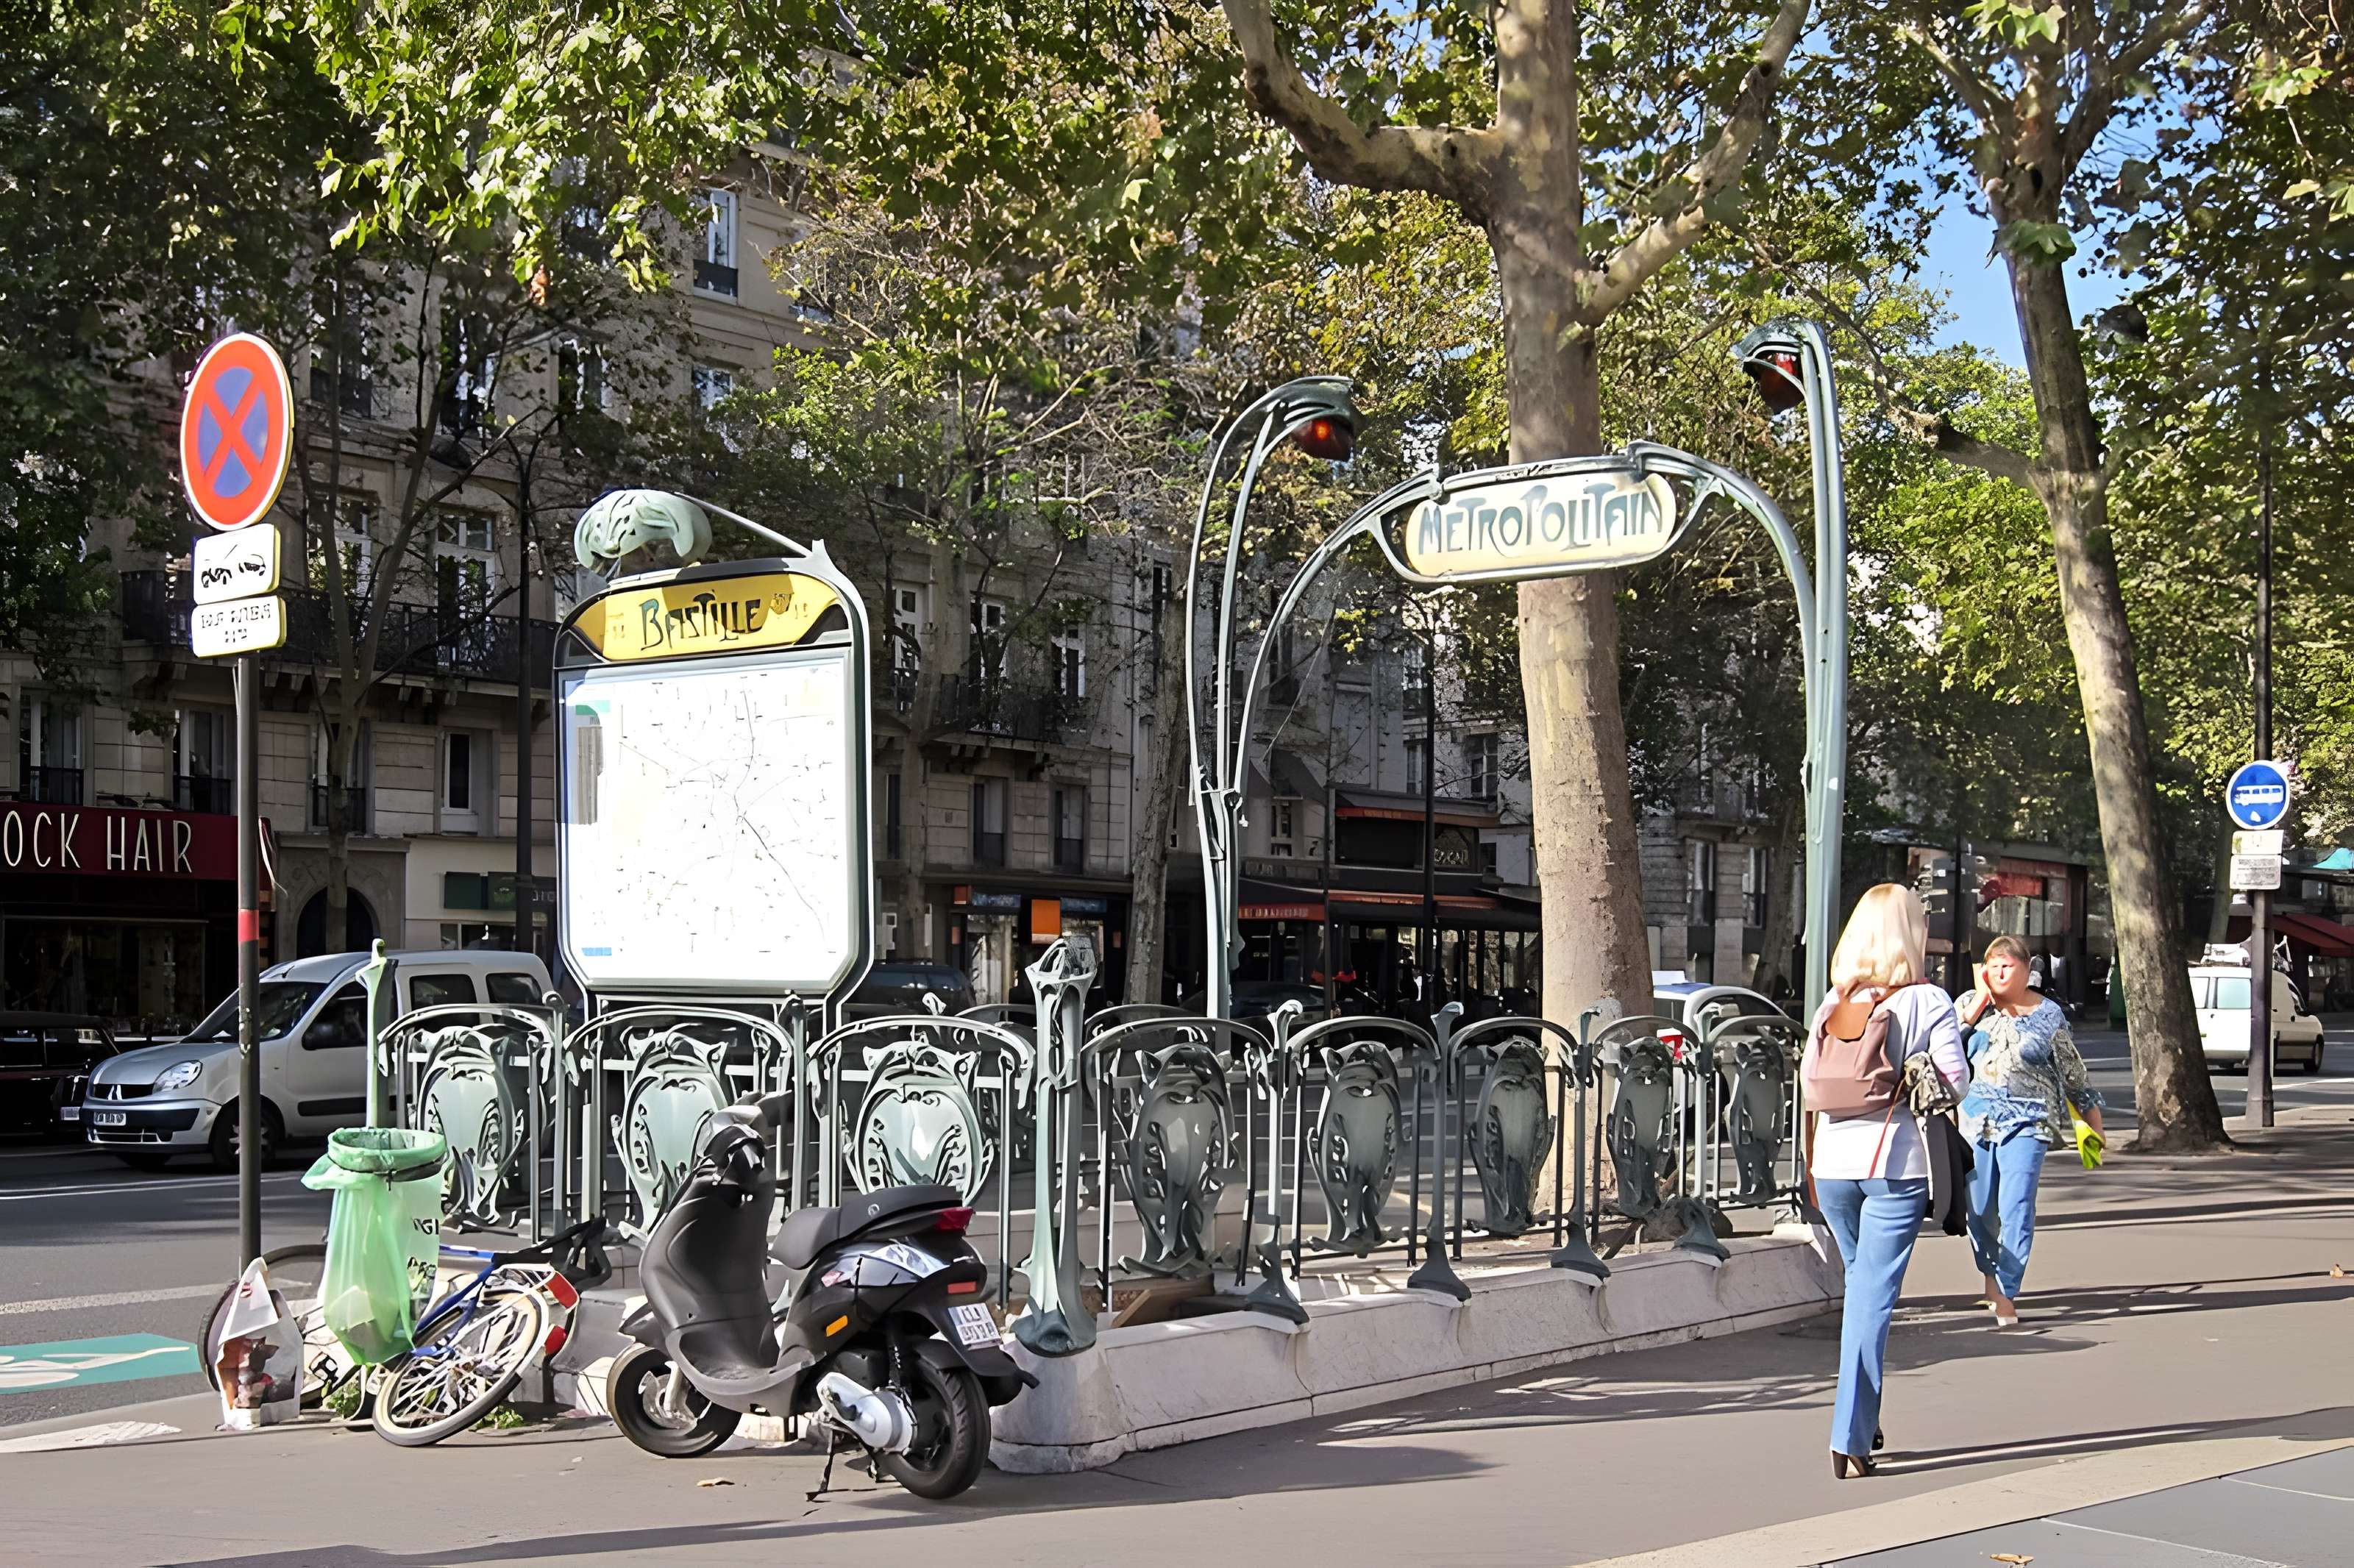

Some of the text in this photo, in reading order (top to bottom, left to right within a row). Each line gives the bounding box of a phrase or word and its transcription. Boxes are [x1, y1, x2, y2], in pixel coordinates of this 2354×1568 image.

[1418, 482, 1663, 558] METROPOLITAIN
[639, 589, 763, 651] BASTILLE
[3, 810, 193, 873] OCK HAIR
